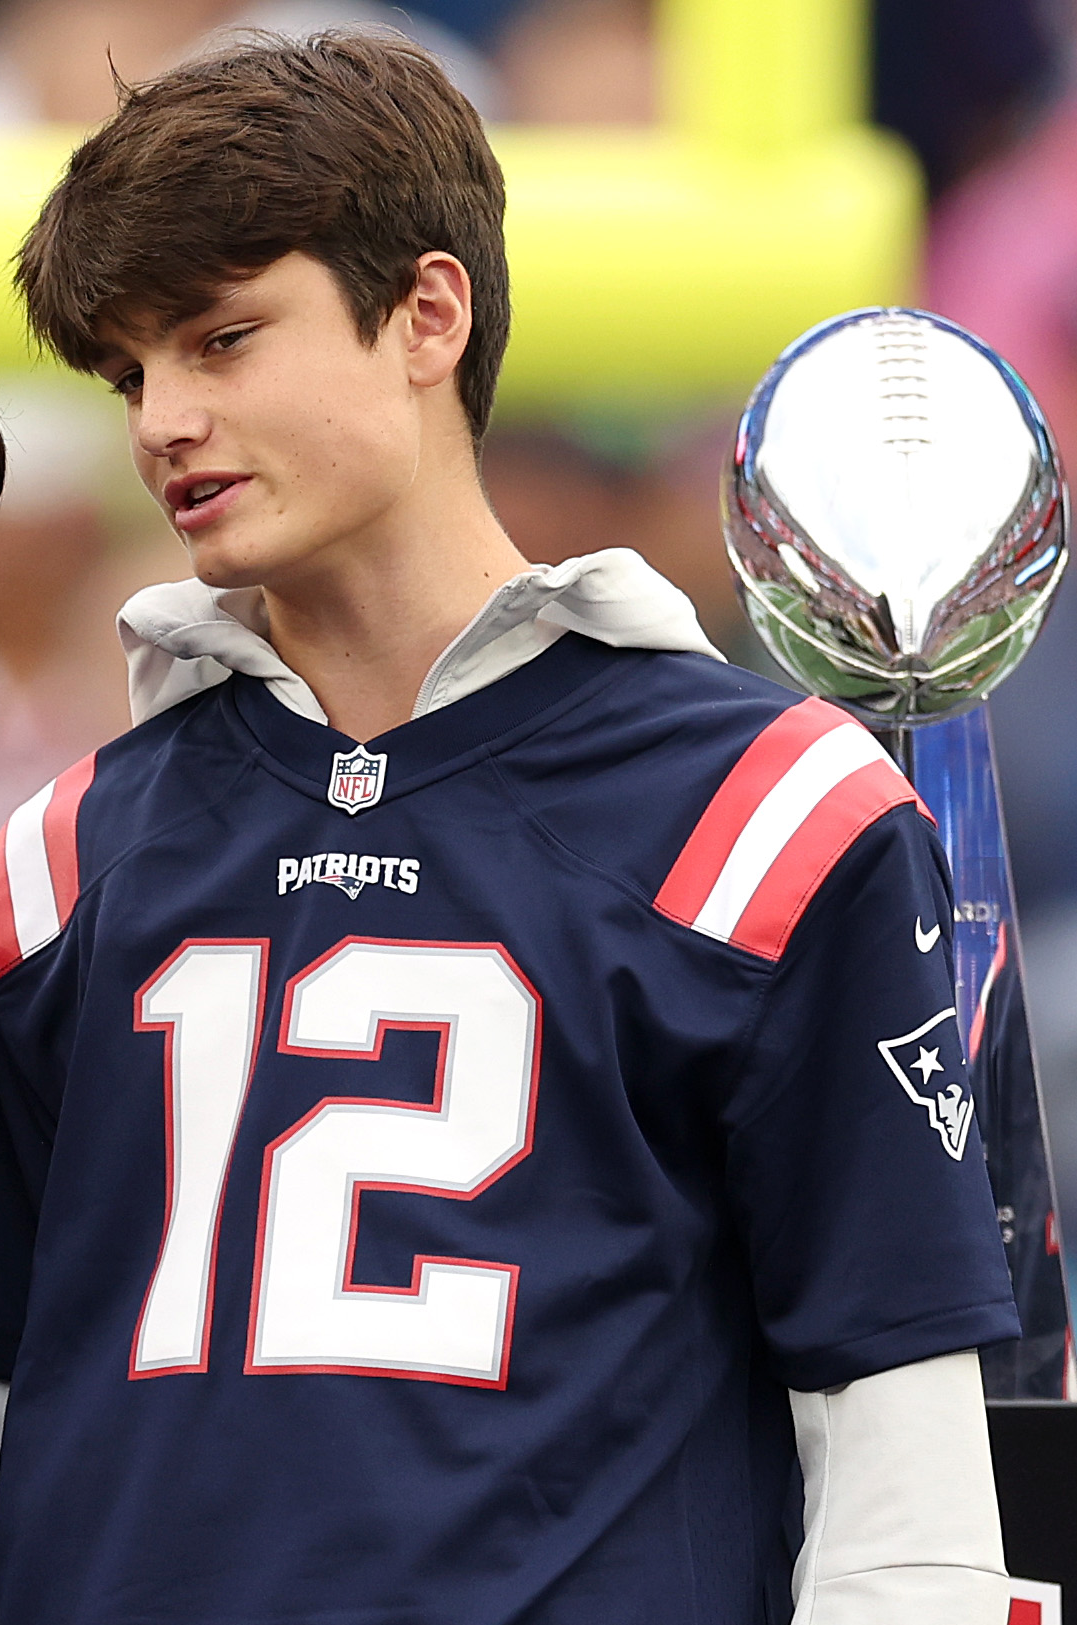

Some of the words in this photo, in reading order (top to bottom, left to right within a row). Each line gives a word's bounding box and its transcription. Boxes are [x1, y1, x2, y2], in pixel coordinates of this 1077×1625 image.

[336, 777, 372, 801] NFL
[277, 853, 421, 896] PATRIOTS
[128, 935, 542, 1391] 12
